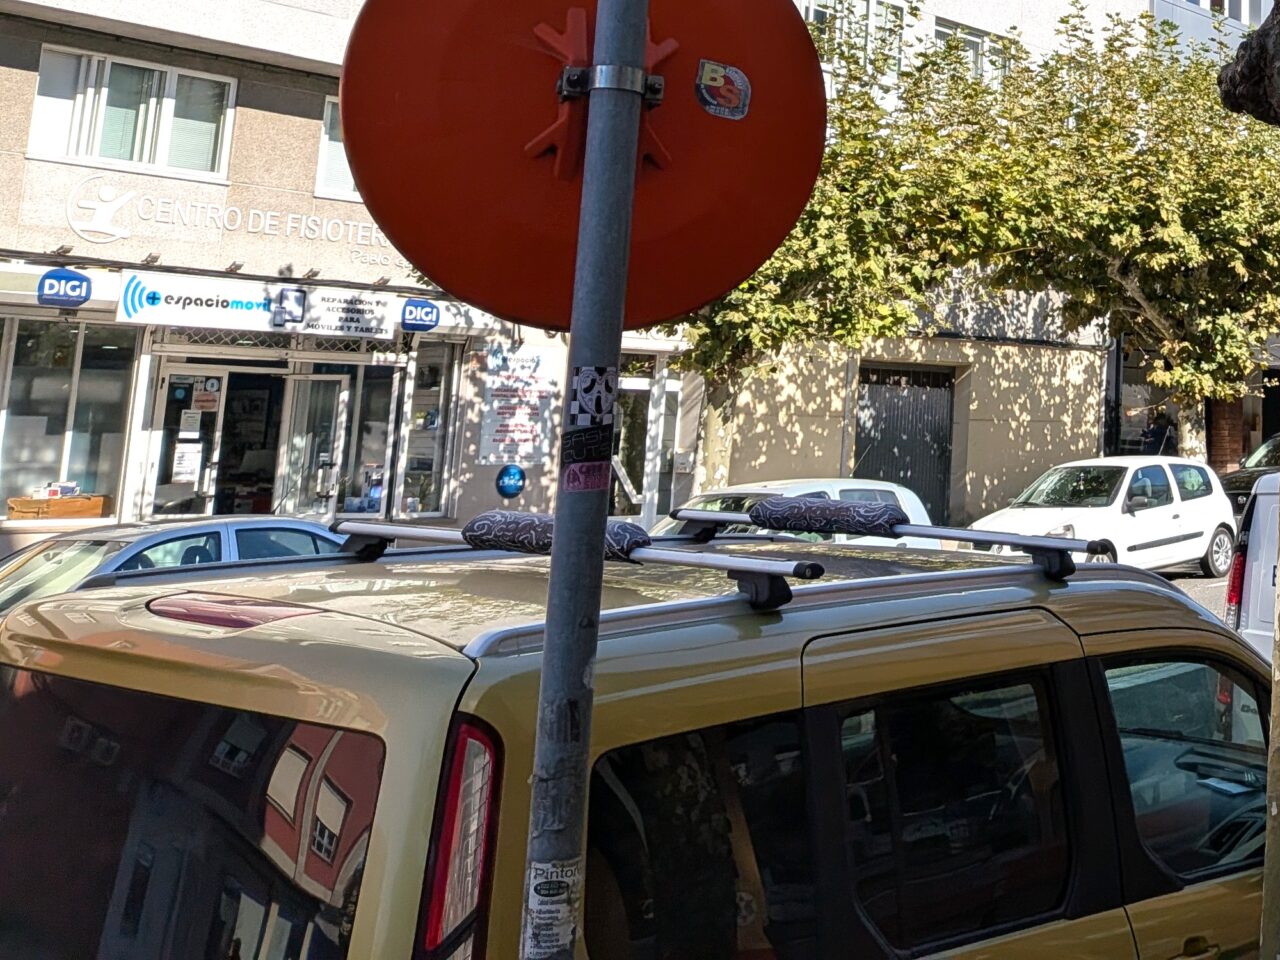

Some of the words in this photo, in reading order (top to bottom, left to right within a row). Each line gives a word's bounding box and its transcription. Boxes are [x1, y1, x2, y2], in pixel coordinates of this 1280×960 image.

[137, 197, 242, 232] CENTRO
[247, 209, 280, 235] DE
[43, 278, 87, 297] DIGI
[338, 316, 360, 324] PARA
[404, 305, 437, 322] DIGI
